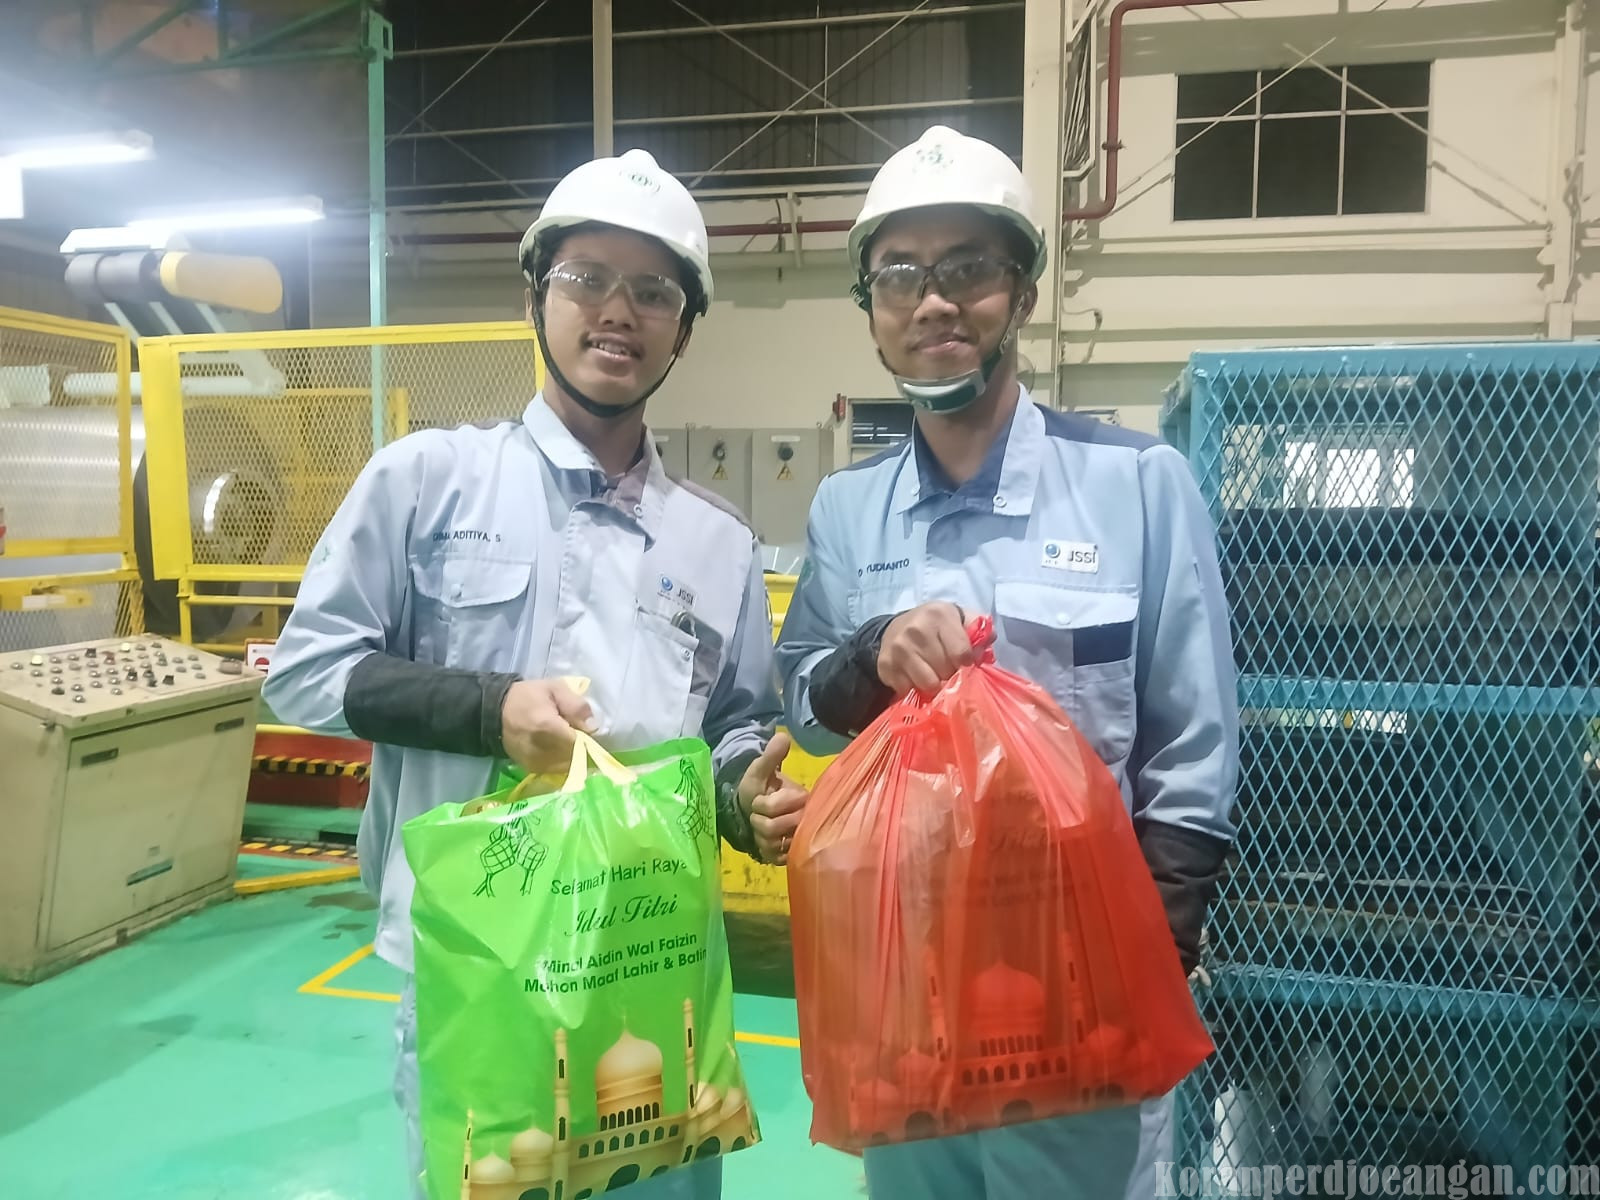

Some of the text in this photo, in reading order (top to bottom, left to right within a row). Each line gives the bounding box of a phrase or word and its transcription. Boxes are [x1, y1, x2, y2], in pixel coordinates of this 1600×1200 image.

[1068, 551, 1096, 563] JSSI
[551, 870, 606, 895] Selamat
[611, 861, 646, 883] Hari
[564, 906, 617, 937] Idul
[587, 949, 623, 969] Aidin
[627, 940, 654, 958] Wal
[659, 933, 697, 952] Faizin
[583, 967, 619, 990] Maaf
[623, 959, 659, 980] Lahir
[664, 957, 674, 970] &
